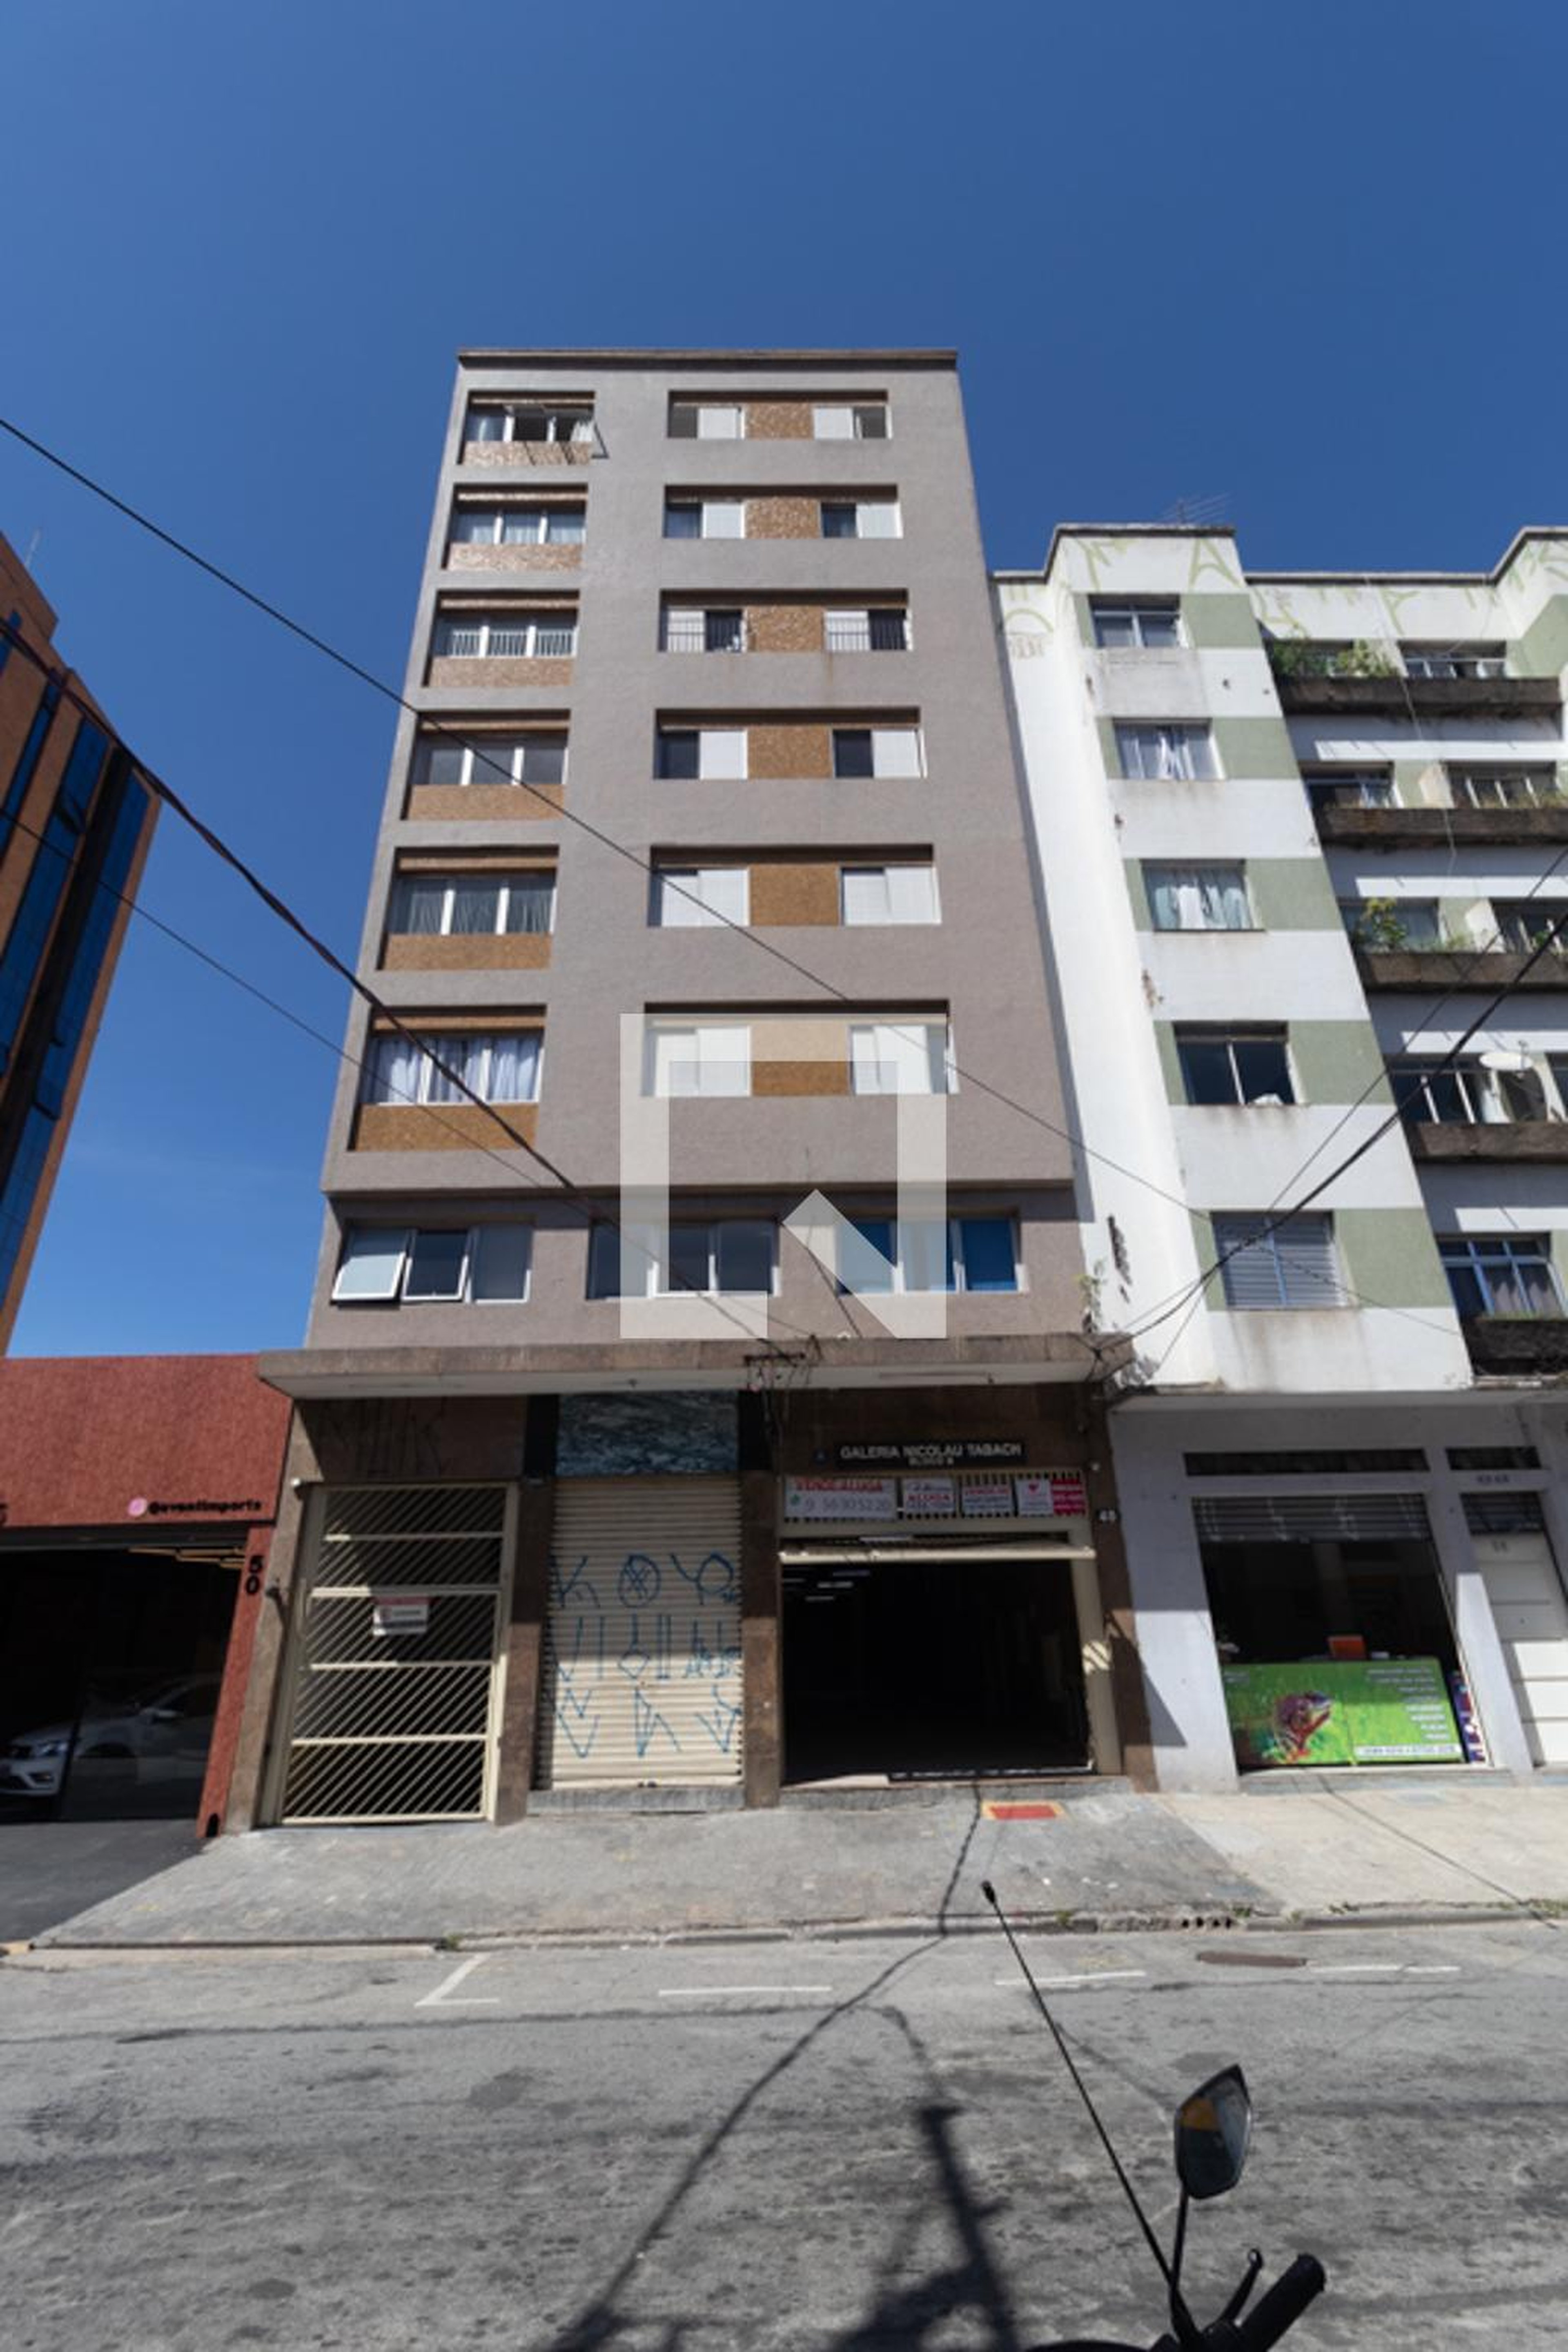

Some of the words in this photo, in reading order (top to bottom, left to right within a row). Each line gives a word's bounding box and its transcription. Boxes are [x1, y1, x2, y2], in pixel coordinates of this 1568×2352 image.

[840, 1445, 900, 1459] GALERIA
[902, 1444, 963, 1458] NICOLAU
[967, 1442, 1022, 1456] TABACH
